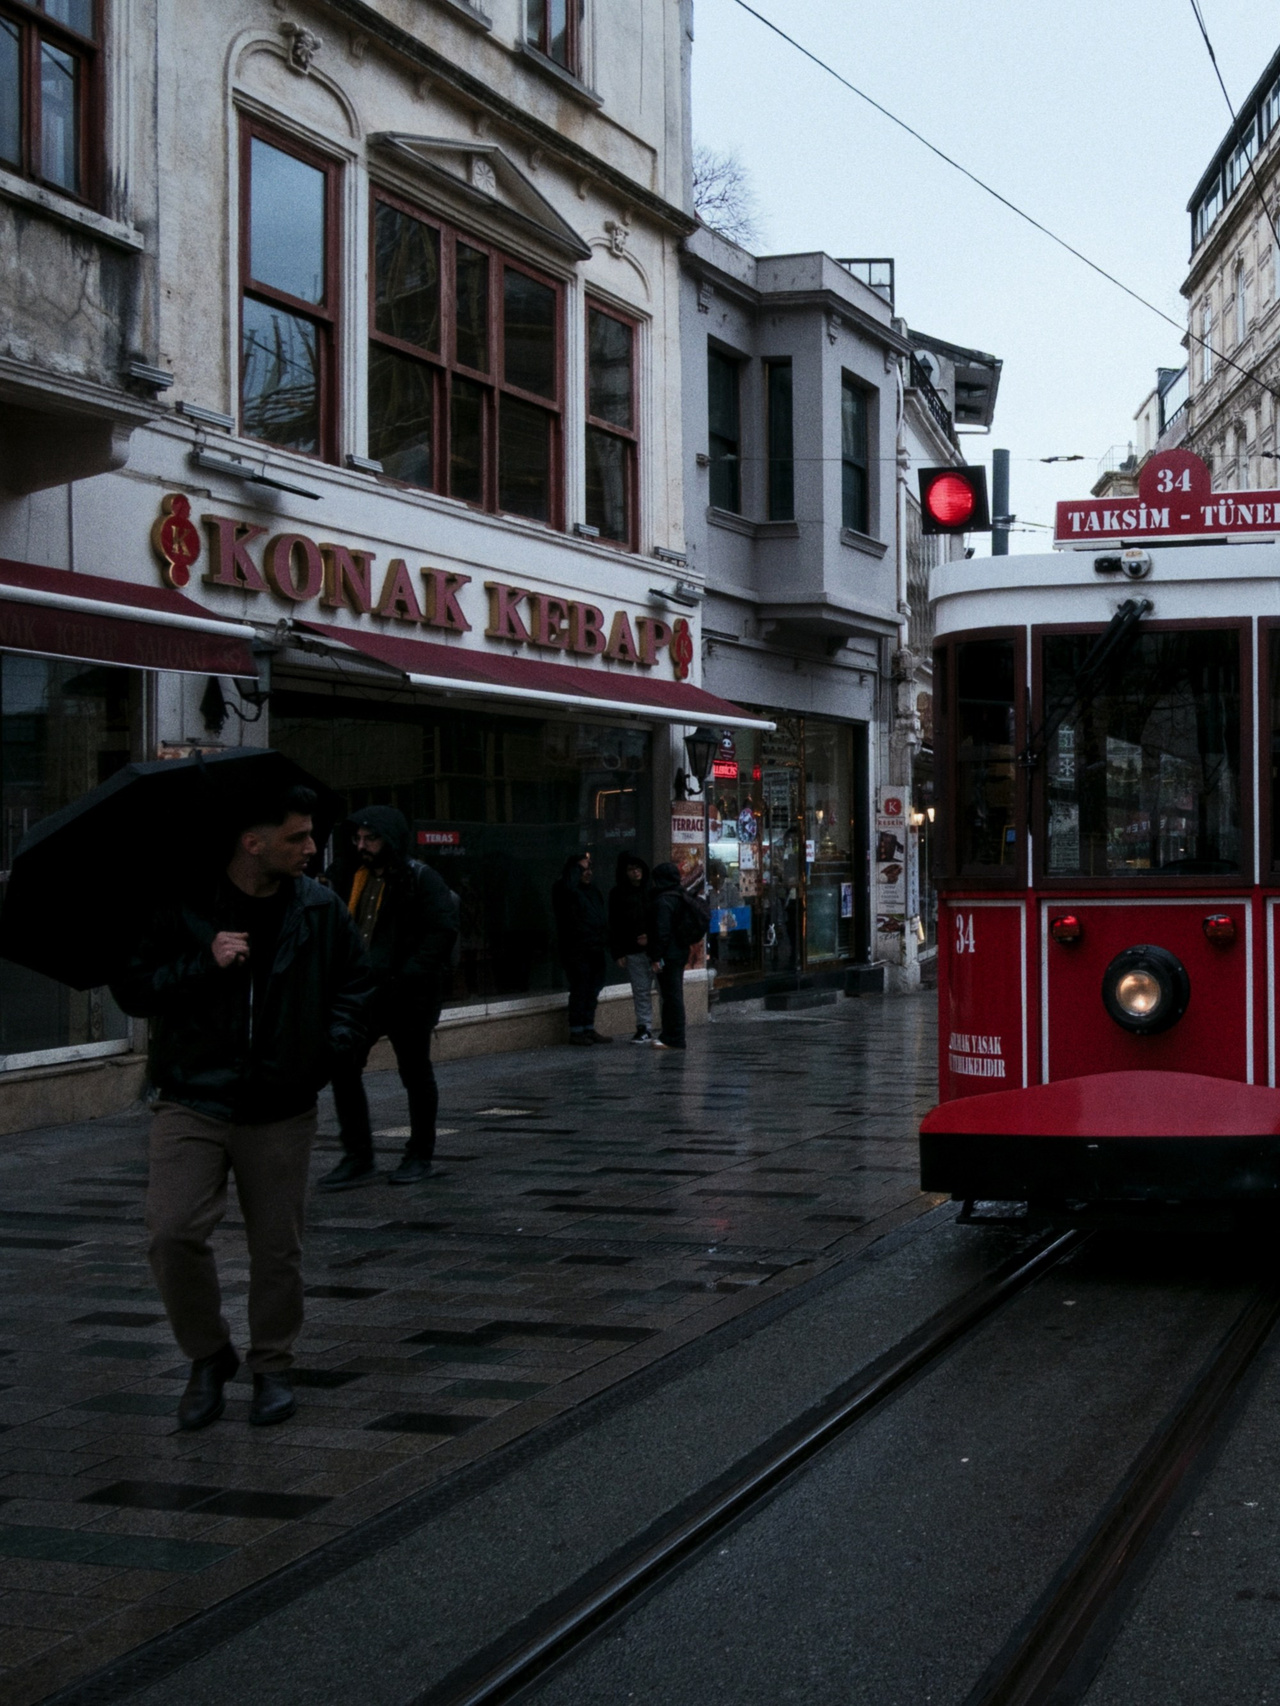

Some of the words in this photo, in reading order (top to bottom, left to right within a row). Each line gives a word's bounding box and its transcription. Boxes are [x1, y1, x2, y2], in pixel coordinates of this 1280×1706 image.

[1156, 468, 1192, 493] 34
[1068, 502, 1170, 532] TAKSİM
[171, 525, 191, 556] K
[201, 514, 472, 633] KONAK
[484, 581, 673, 666] KEBAP
[425, 832, 454, 842] TERAS
[672, 818, 704, 832] TERRACE
[956, 913, 975, 954] 34
[971, 1034, 1002, 1055] YASAK
